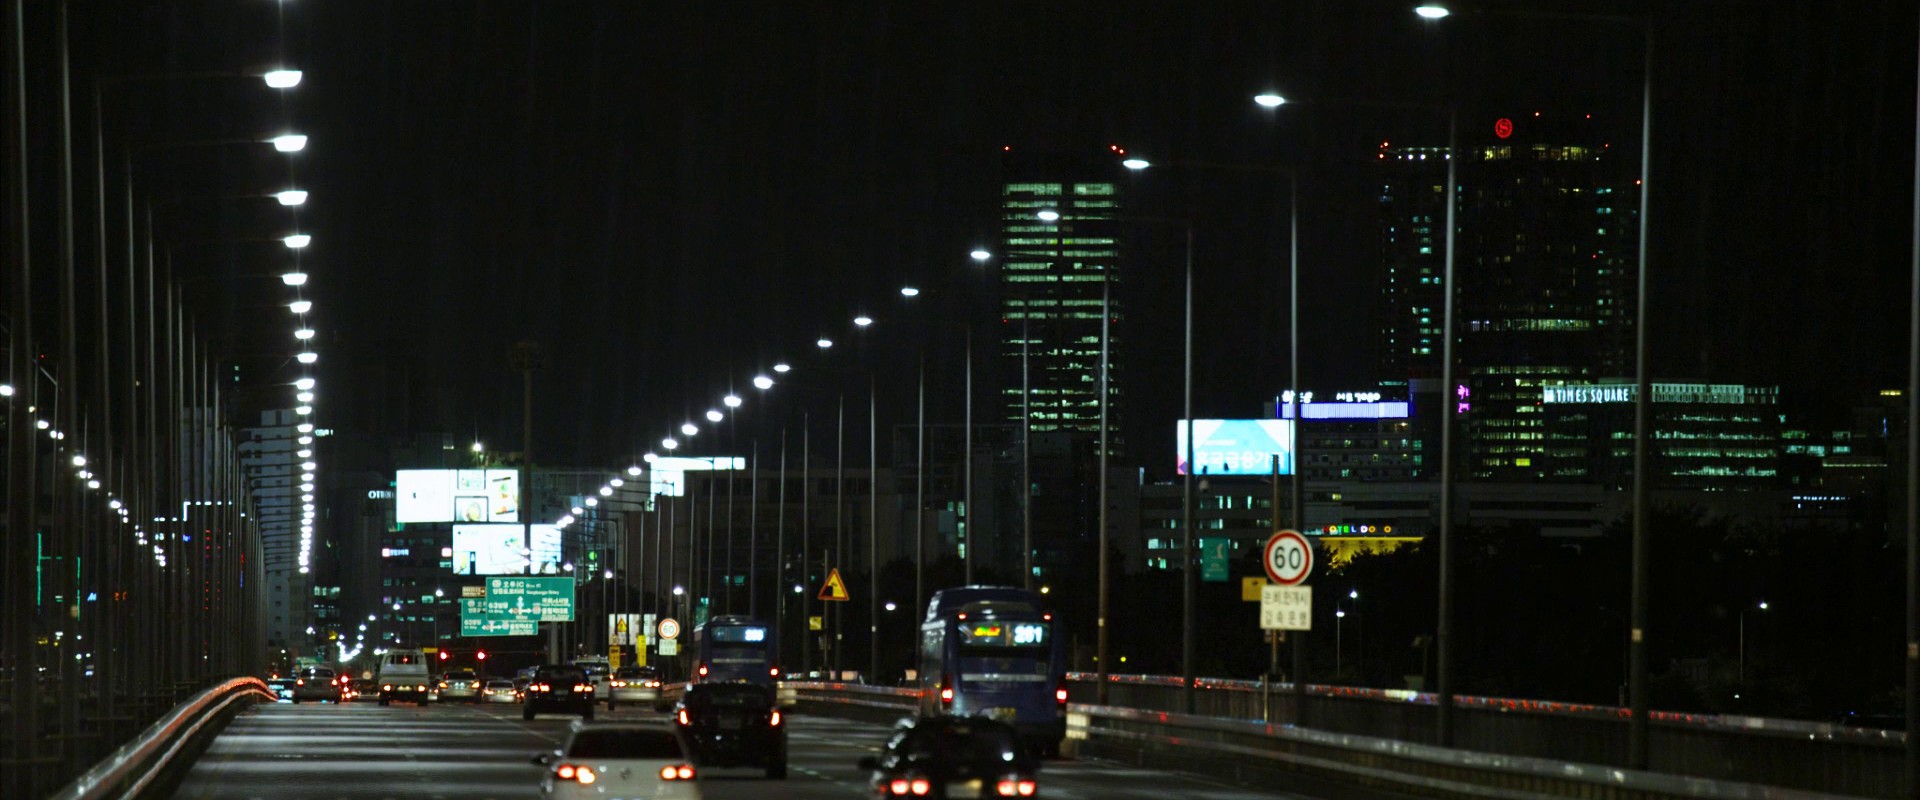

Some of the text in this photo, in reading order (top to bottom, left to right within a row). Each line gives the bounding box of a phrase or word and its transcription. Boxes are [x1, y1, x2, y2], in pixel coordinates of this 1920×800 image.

[1556, 387, 1630, 404] TIMES SQUARE
[1274, 546, 1302, 570] 60
